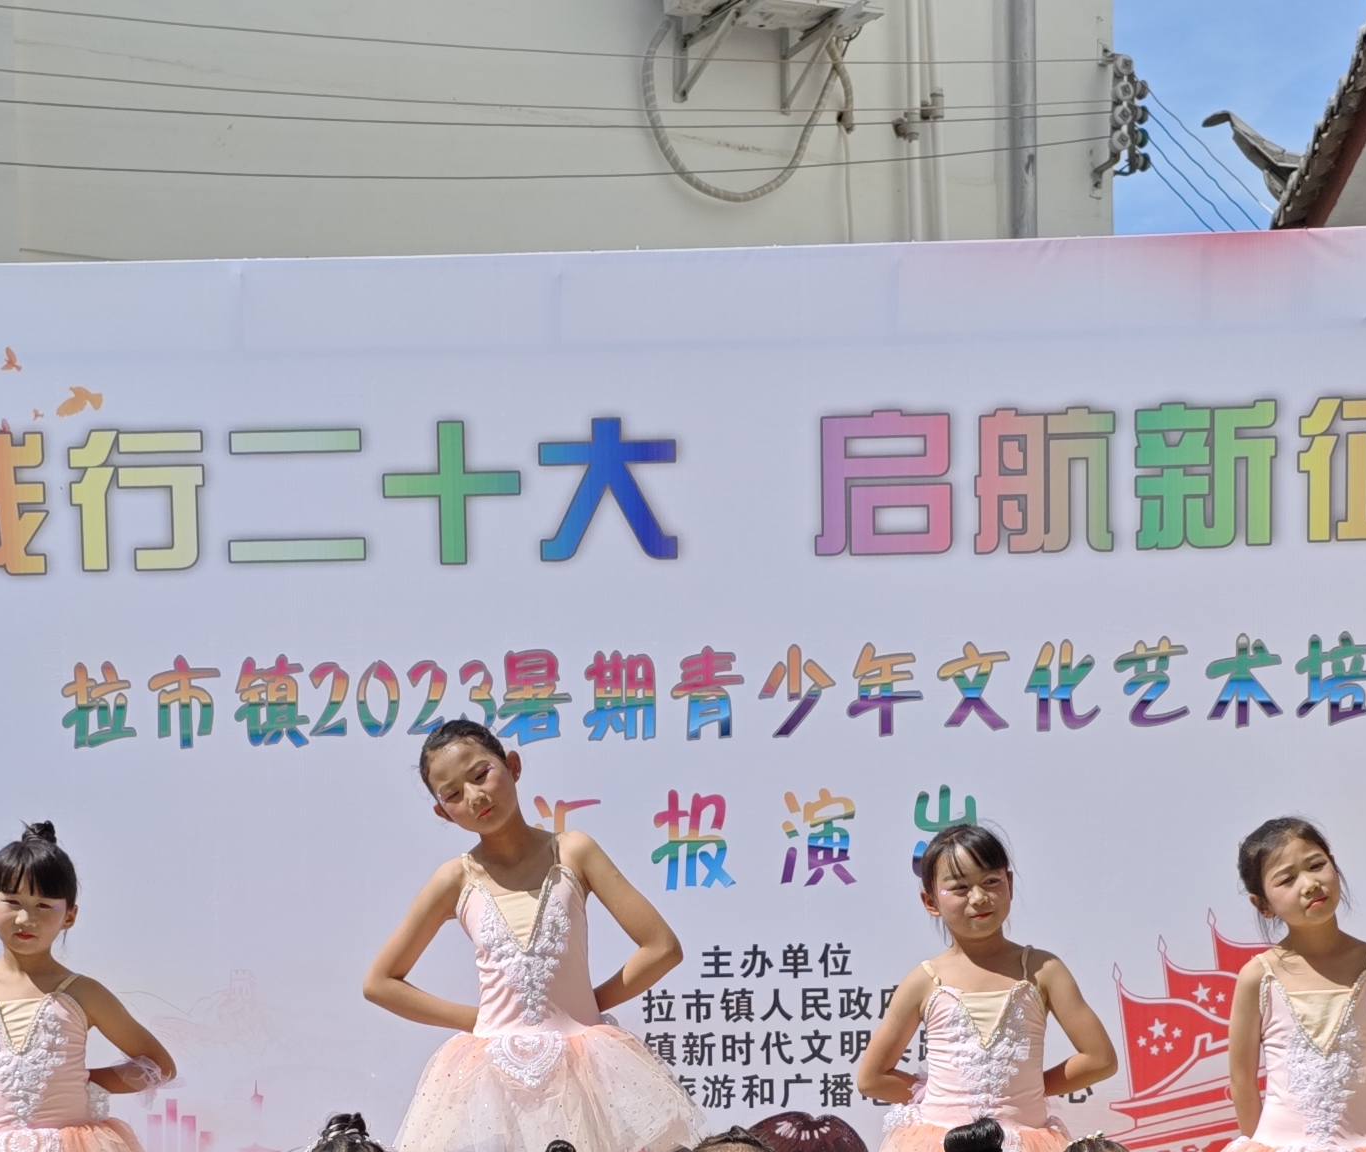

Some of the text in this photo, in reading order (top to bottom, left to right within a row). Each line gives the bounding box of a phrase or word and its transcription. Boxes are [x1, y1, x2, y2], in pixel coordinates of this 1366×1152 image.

[700, 941, 853, 979] 主办单位
[644, 1029, 928, 1067] 镇新时代文明
[677, 1073, 892, 1108] 游和广播
